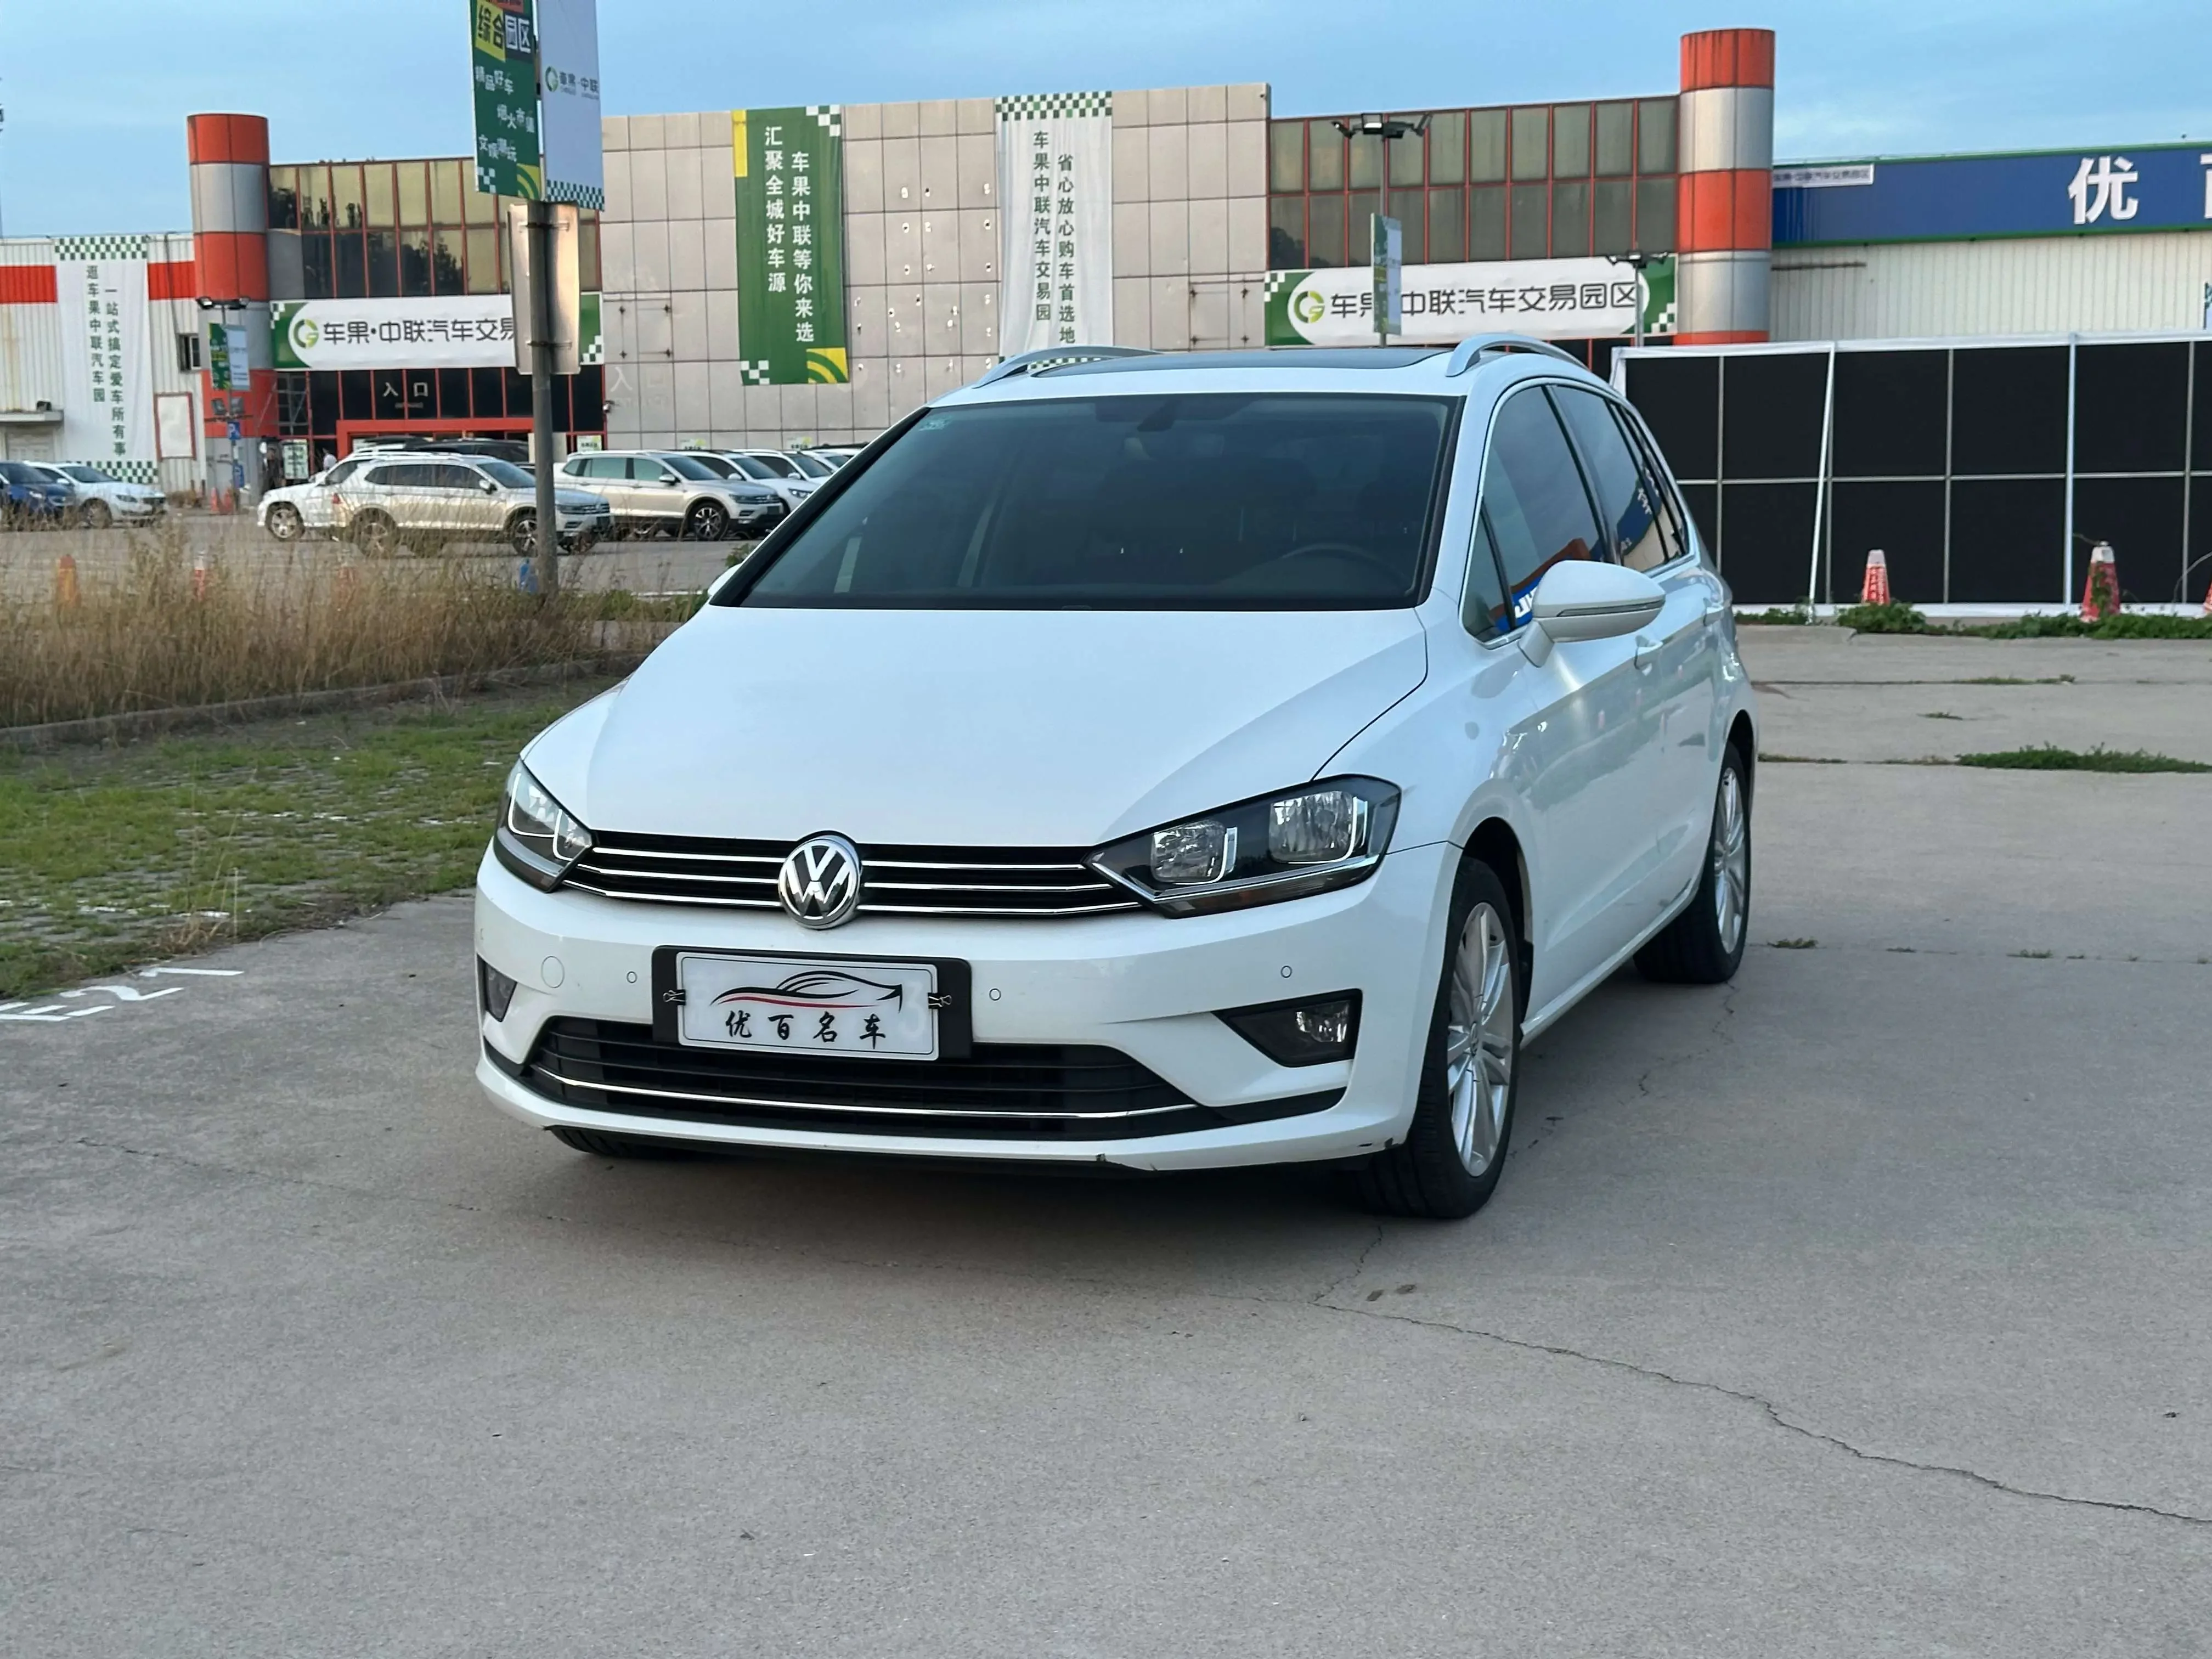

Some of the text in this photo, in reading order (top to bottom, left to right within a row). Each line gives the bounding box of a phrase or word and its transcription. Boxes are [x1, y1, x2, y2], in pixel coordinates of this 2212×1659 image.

[765, 126, 786, 292] 汇聚全城好车源
[791, 151, 815, 342] 车果中联等你来选
[1033, 131, 1051, 321] 车果中联汽车交易园
[1058, 154, 1075, 343] 省心放心购车首选地
[1330, 281, 1637, 318] 车中联汽车交易园区
[382, 381, 428, 397] 入口
[725, 1010, 887, 1050] 优百名车
